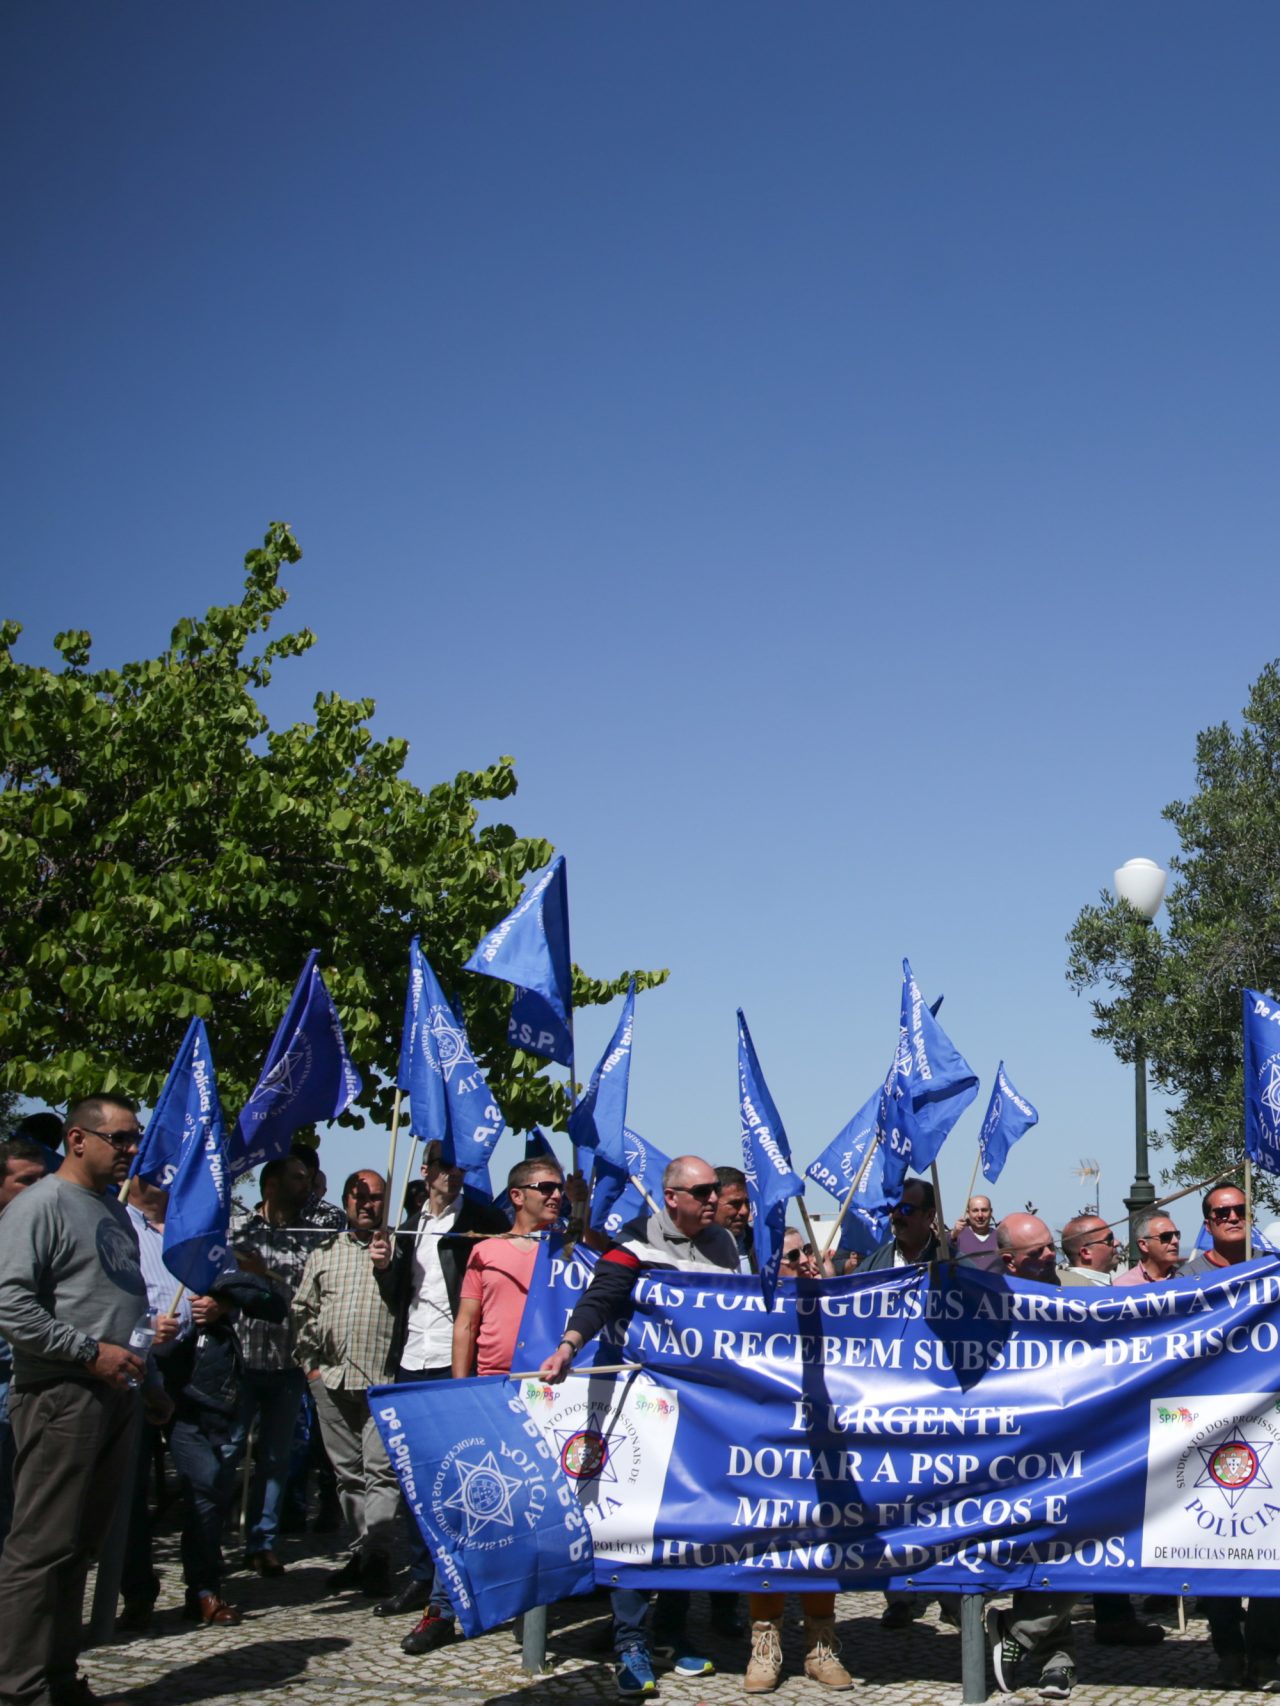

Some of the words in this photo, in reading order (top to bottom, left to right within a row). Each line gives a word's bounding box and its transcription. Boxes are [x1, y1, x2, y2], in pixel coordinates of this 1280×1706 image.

[1254, 1000, 1271, 1017] De
[192, 1059, 211, 1113] Polícias
[624, 1129, 647, 1172] OFISSIONAIS
[754, 1125, 792, 1176] Polícias
[809, 1161, 839, 1192] S.P.P.
[548, 1259, 684, 1307] POIAS
[974, 1288, 1178, 1323] ARRISCAM
[1188, 1287, 1213, 1312] A
[563, 1308, 630, 1347] AS
[638, 1319, 703, 1358] NÃO
[712, 1328, 904, 1369] RECEBEM
[913, 1331, 1102, 1371] SUBSÍDIO
[1104, 1335, 1153, 1365] DE
[526, 1388, 561, 1401] SPP/PSP
[635, 1400, 676, 1415] SPP/PSP
[789, 1393, 814, 1432] É
[826, 1403, 1022, 1436] URGENTE
[1159, 1412, 1200, 1424] SPP/PSP
[564, 1402, 588, 1417] DOS
[627, 1469, 641, 1485] DE
[1177, 1431, 1205, 1489] SINDICATO
[1205, 1417, 1230, 1433] DOS
[727, 1444, 865, 1482] DOTAR
[871, 1454, 900, 1484] A
[908, 1452, 980, 1485] PSP
[988, 1450, 1084, 1482] COM
[732, 1496, 864, 1529] MEIOS
[878, 1495, 1031, 1529] FÍSICOS
[1045, 1495, 1069, 1526] E
[593, 1539, 647, 1556] POLÍCIAS
[661, 1538, 865, 1571] HUMANOS
[874, 1536, 1136, 1573] ADEQUADOS.
[1154, 1546, 1168, 1559] DE
[1170, 1544, 1226, 1560] POLÍCIAS
[1228, 1547, 1254, 1560] PARA
